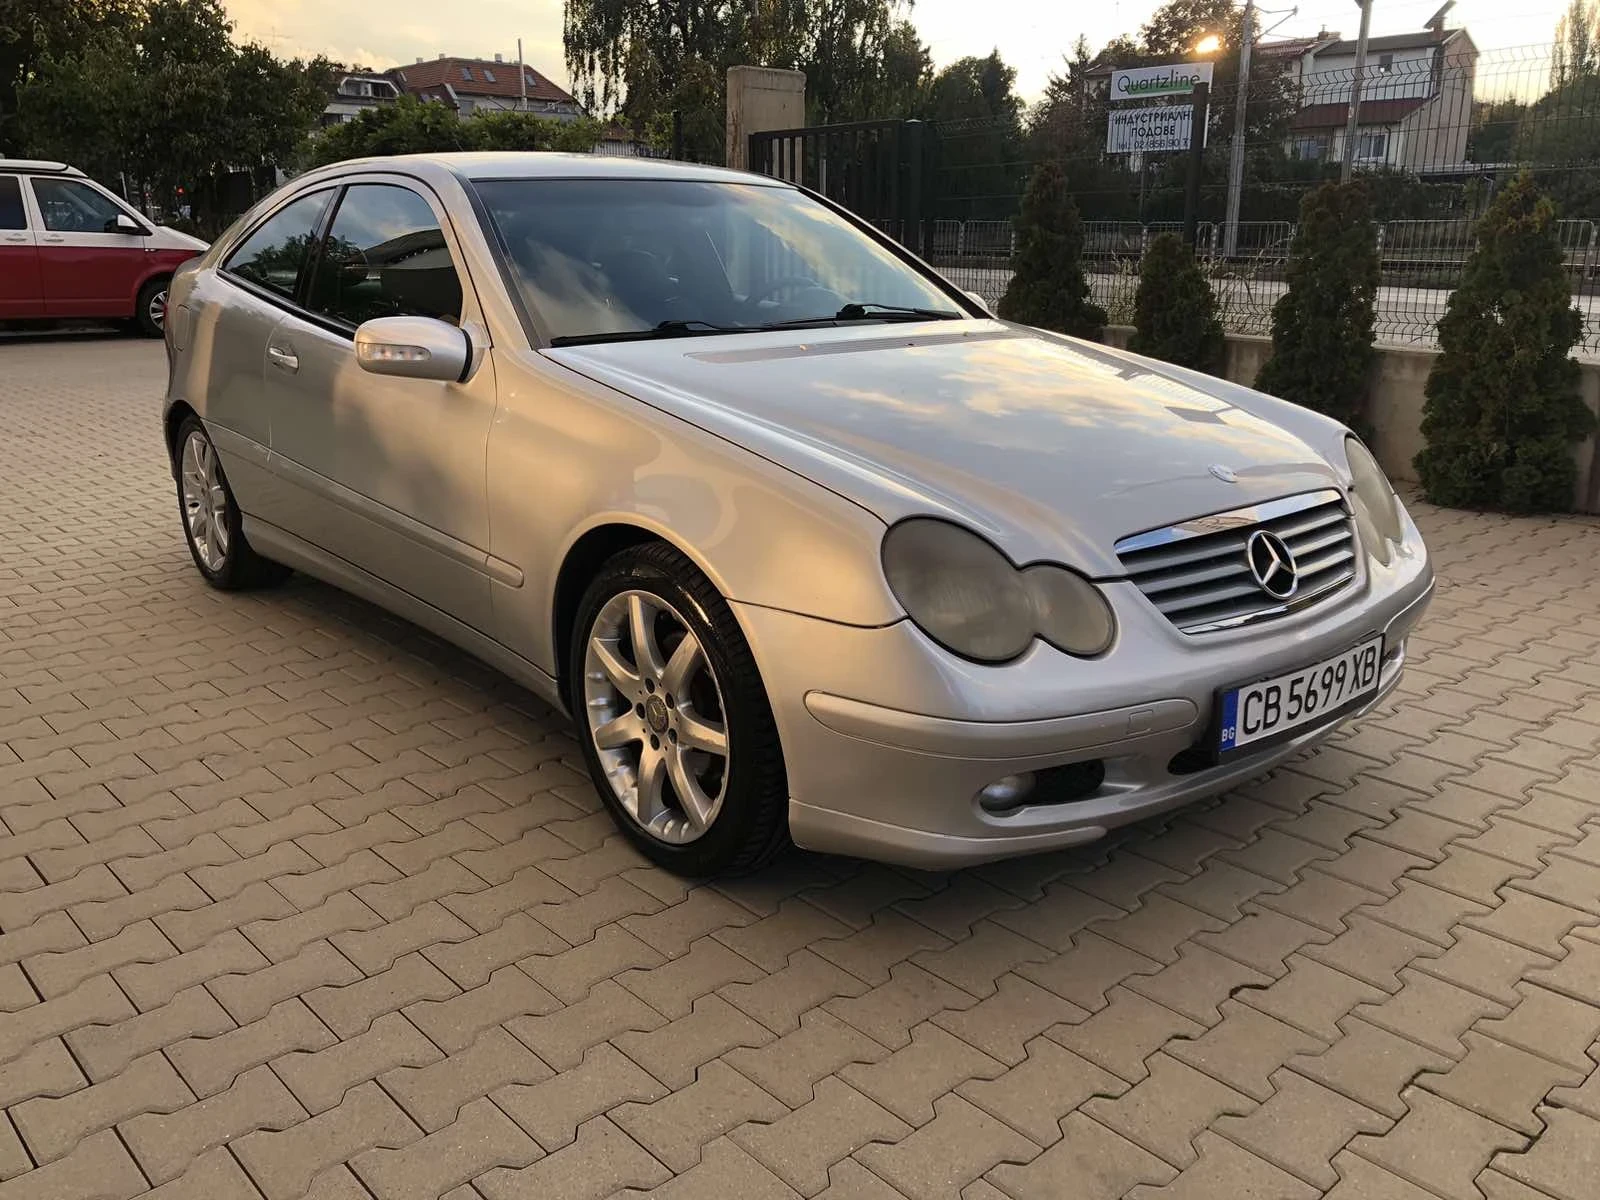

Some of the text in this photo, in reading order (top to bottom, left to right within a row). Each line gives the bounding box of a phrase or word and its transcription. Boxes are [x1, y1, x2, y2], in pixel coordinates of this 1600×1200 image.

[1117, 69, 1200, 95] Quartzline
[1115, 111, 1192, 125] ИНДУСТРИАЛН
[1132, 125, 1176, 138] ПОДОВЕ
[1243, 645, 1377, 735] CB 5699 XB
[1221, 726, 1236, 743] BG
